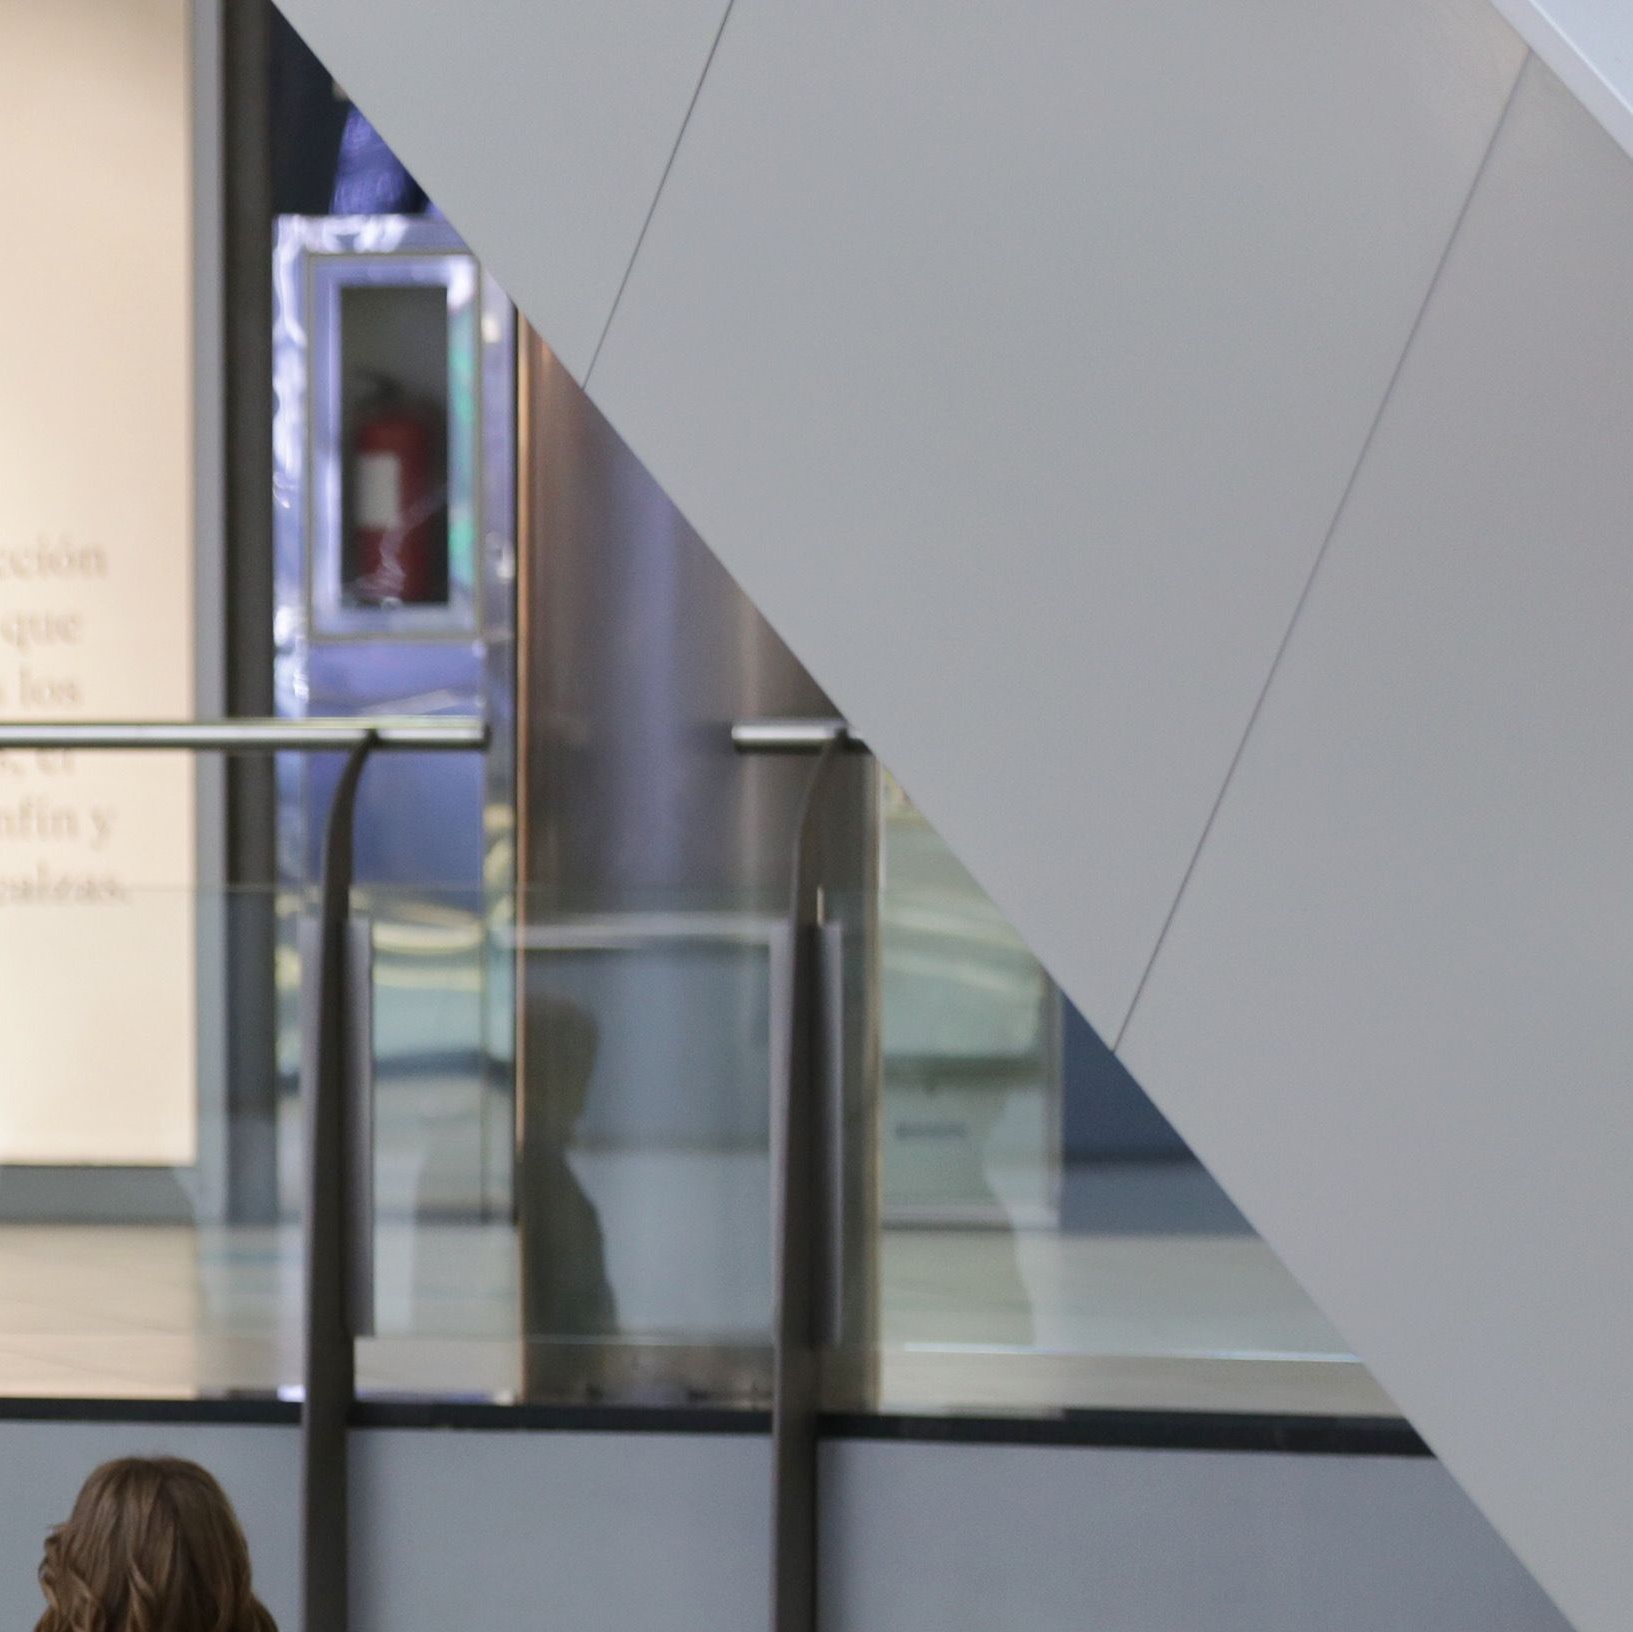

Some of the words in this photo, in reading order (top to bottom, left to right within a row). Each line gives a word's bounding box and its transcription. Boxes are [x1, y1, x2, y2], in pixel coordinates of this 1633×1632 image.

[0, 610, 84, 655] que
[19, 662, 84, 707] los
[90, 806, 118, 851] y
